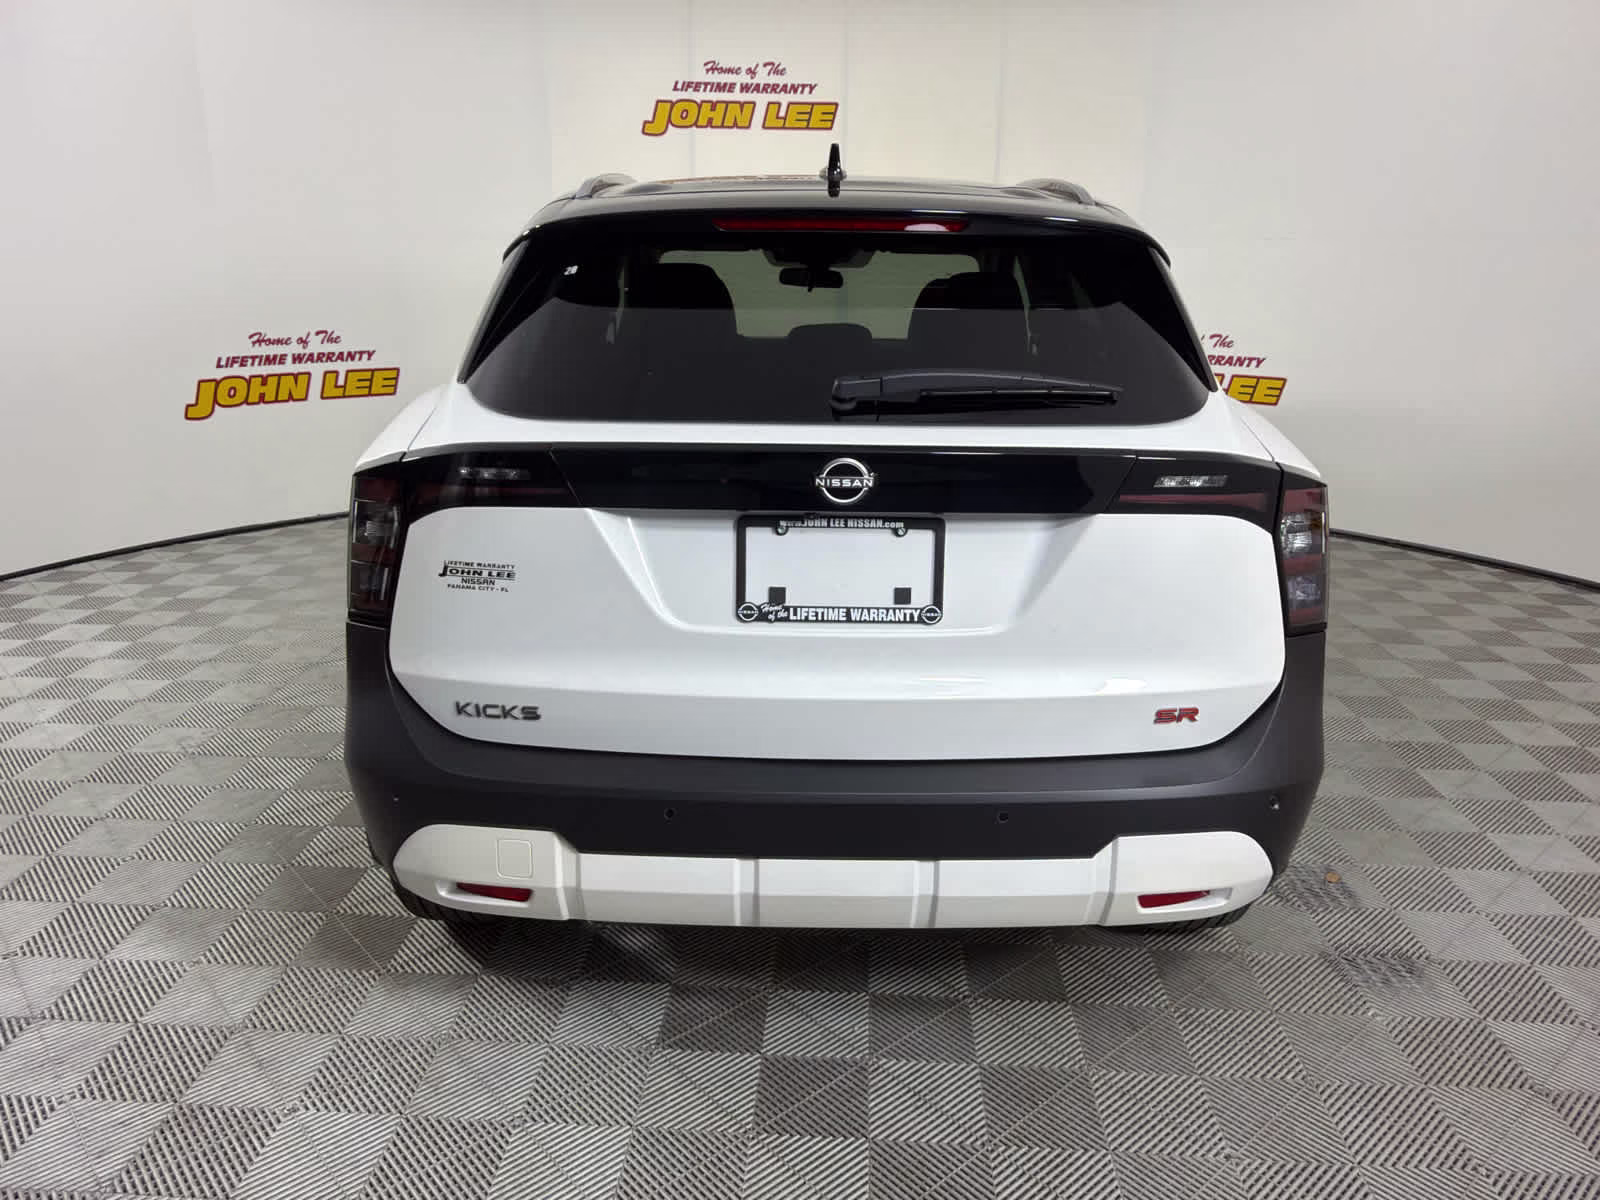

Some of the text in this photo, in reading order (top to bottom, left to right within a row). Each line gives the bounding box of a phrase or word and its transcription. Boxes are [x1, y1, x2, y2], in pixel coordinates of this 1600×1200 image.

[704, 60, 787, 79] Home of The
[672, 81, 817, 95] LIFETIME WARRANTY
[642, 99, 839, 136] JOHN LEE
[248, 330, 342, 348] Home of The
[1209, 333, 1234, 348] The
[216, 350, 376, 369] LIFETIME WARRANTY
[1207, 354, 1266, 368] RRANTY
[184, 367, 400, 421] JOHN LEE
[815, 478, 873, 488] NISSAN
[438, 563, 516, 579] JOHN LEE
[461, 578, 496, 586] NISSAN
[789, 607, 921, 622] LIFETIME WARRANTY
[455, 701, 542, 721] KICKS
[1153, 707, 1199, 725] SR
